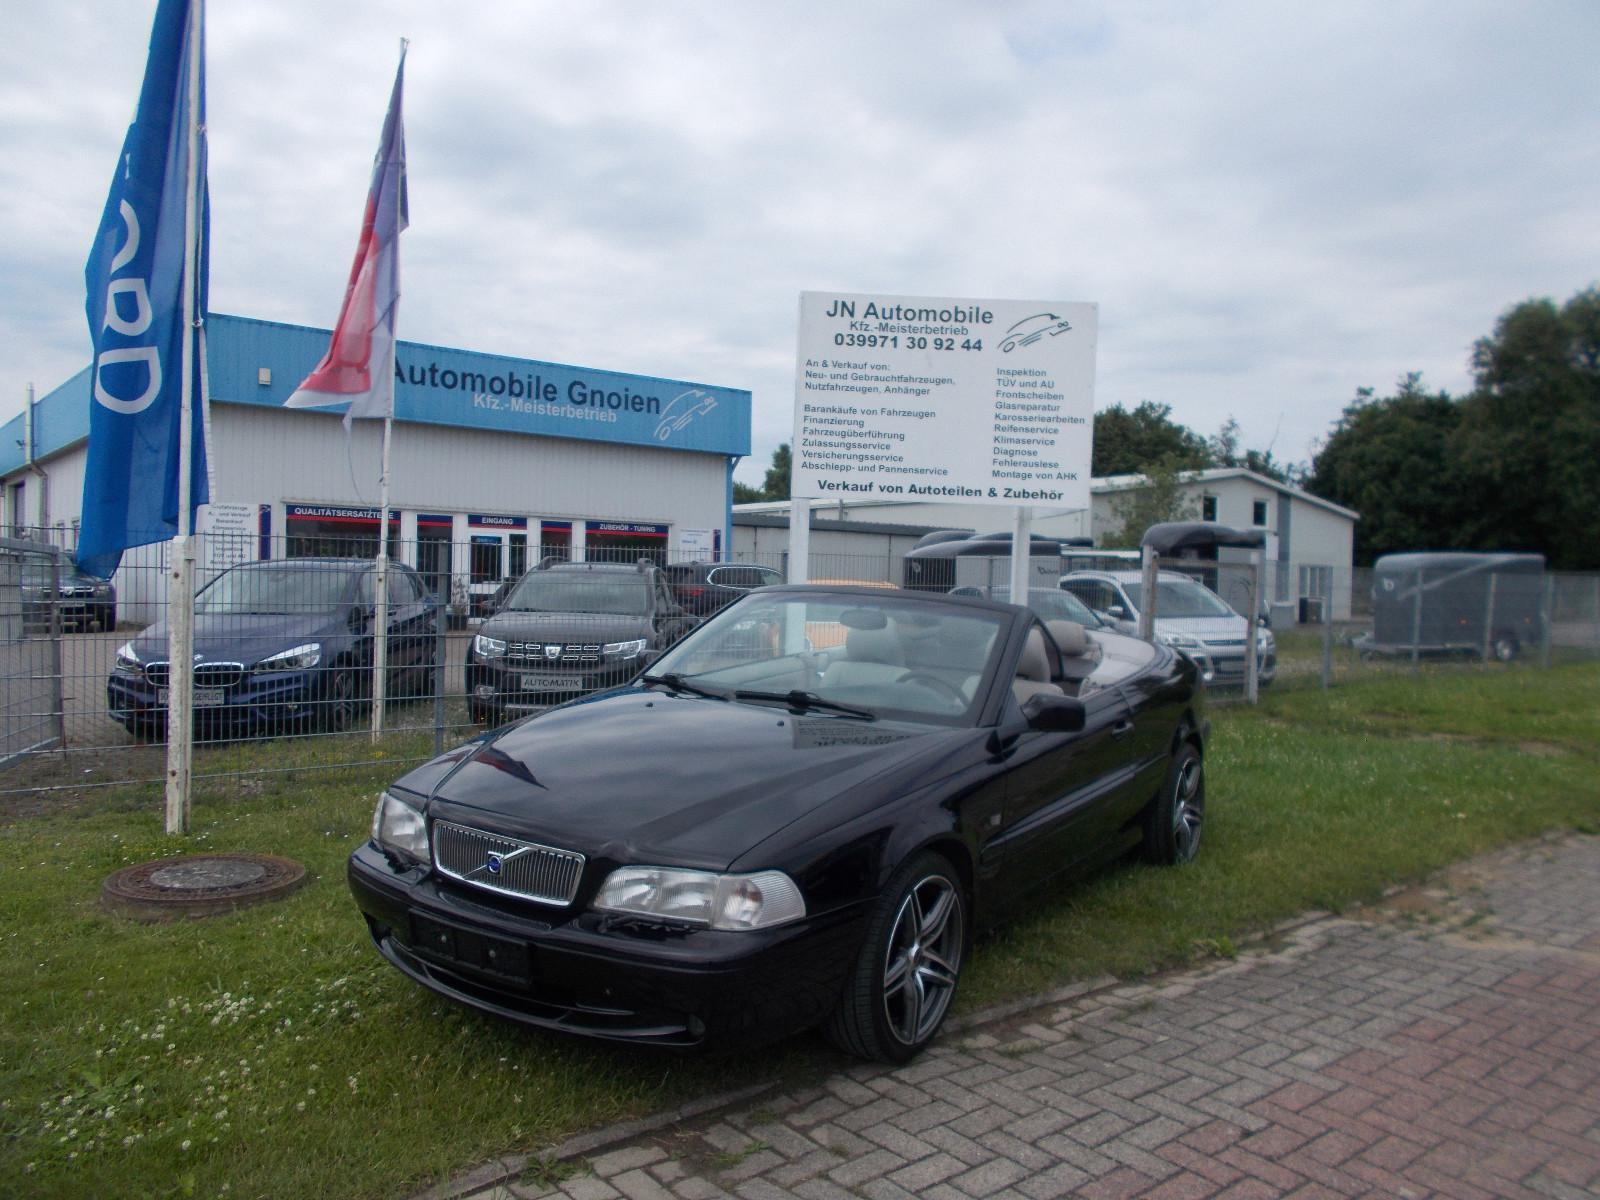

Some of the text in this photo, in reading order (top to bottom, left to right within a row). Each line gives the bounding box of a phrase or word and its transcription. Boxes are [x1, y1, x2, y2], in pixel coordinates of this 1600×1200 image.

[826, 300, 994, 324] JN Automobile
[850, 321, 969, 336] Kfz.-Meisterbetrieb
[834, 333, 983, 351] 039971 30 92 44
[805, 359, 891, 371] An & Verkauf von:
[805, 371, 828, 379] Neu-
[996, 368, 1047, 377] Inspektion
[996, 378, 1017, 387] TÜV
[884, 386, 931, 396] Anhänger
[996, 390, 1064, 400] Frontscheiben
[567, 380, 660, 415] Gnoien
[473, 393, 617, 422] Kfz.-Meisterbetrieb
[804, 404, 858, 415] Barankäufe
[880, 408, 936, 419] Fahrzeugen
[995, 402, 1061, 411] Glasreparatur
[803, 416, 865, 428] Finanzierung
[994, 413, 1085, 424] Karosseriearbeiten
[803, 427, 905, 441] Fahrzeugüberführung
[994, 424, 1059, 434] Reifenservice
[802, 439, 891, 450] Zulassungsservice
[993, 436, 1056, 446] Klimaservice
[802, 450, 904, 462] Versicherungsservice
[993, 447, 1038, 457] Diagnose
[801, 461, 949, 475] Abschlepp- und Pannenservice
[992, 459, 1060, 468] Fehlerauslese
[992, 470, 1032, 480] Montage
[1056, 472, 1078, 480] AHK
[817, 479, 1065, 501] Verkauf von Autoteilen & Zubehör
[294, 507, 394, 519] QUALITÄTSERSATZTEE
[482, 517, 514, 525] EINGANG
